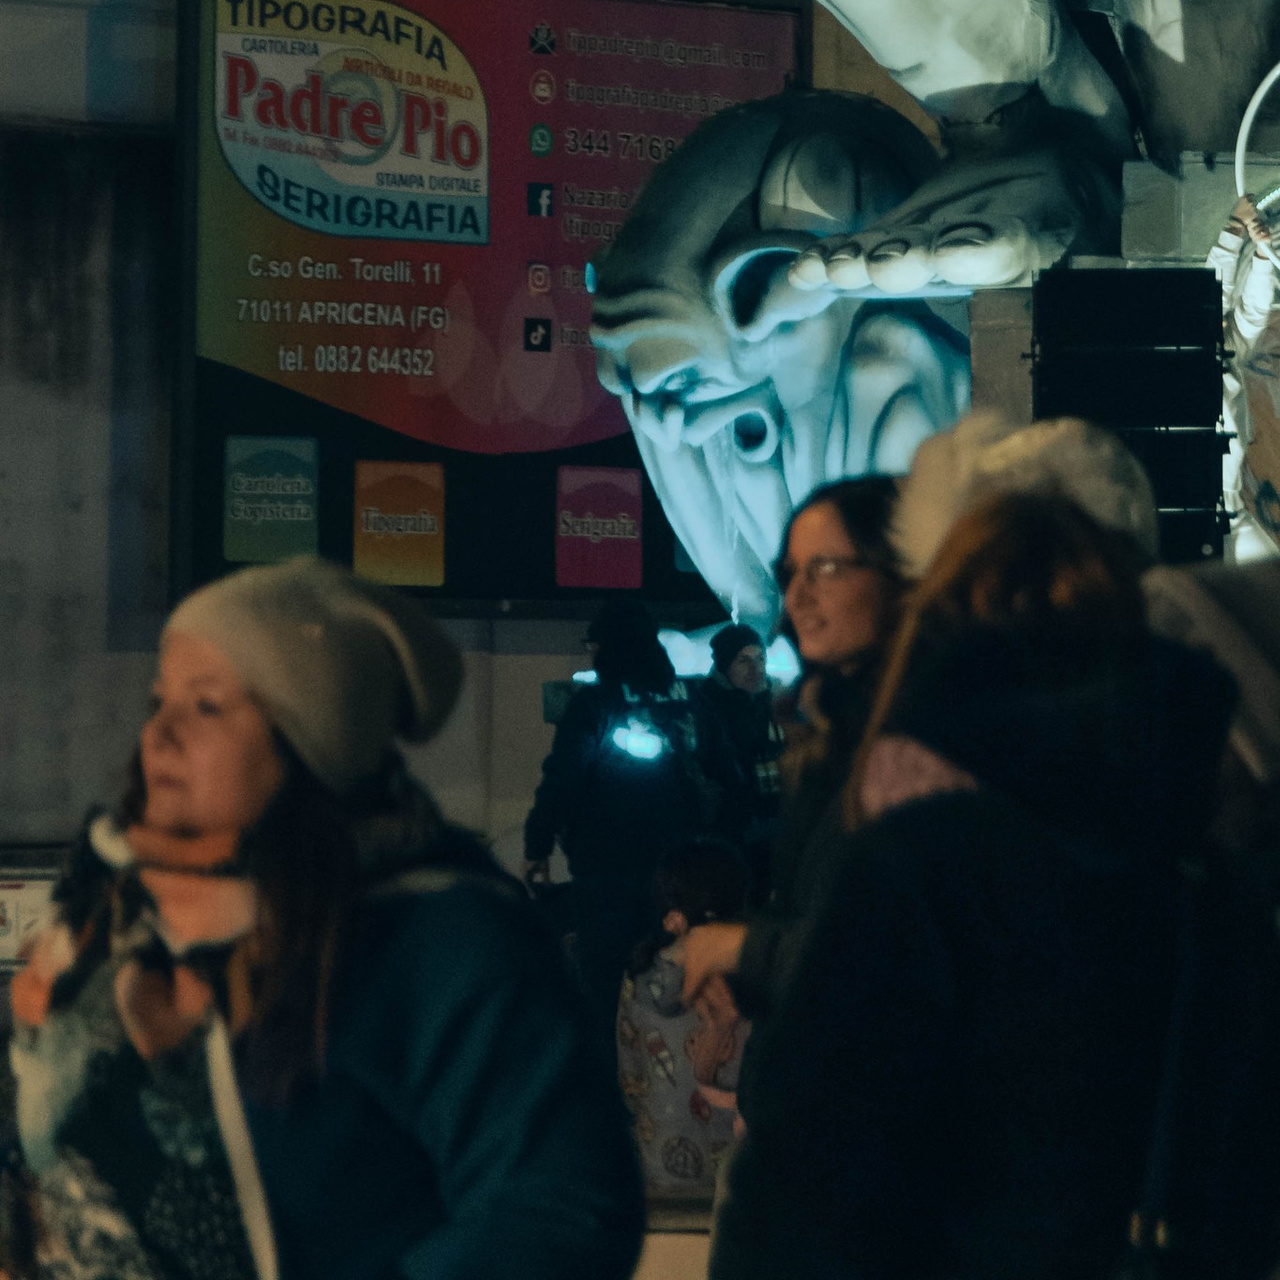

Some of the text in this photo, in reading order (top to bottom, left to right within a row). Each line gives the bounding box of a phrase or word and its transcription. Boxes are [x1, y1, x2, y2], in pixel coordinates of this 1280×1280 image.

[241, 38, 319, 56] CARTOLERIA
[224, 51, 482, 171] Padre Pio
[565, 128, 611, 156] 344
[376, 171, 481, 194] STAMPA DIGITALE
[256, 164, 480, 235] SERIGRAFIA
[248, 254, 293, 278] C.so
[298, 256, 342, 280] Gen.
[422, 262, 441, 285] 11
[237, 299, 450, 333] 71011 APRICENA (FG)
[278, 343, 434, 376] tel. 0882 644352
[230, 472, 314, 494] Cartoleria
[230, 500, 312, 522] Copisteria
[361, 507, 437, 538] Tipografia
[560, 508, 638, 543] Serigrafia
